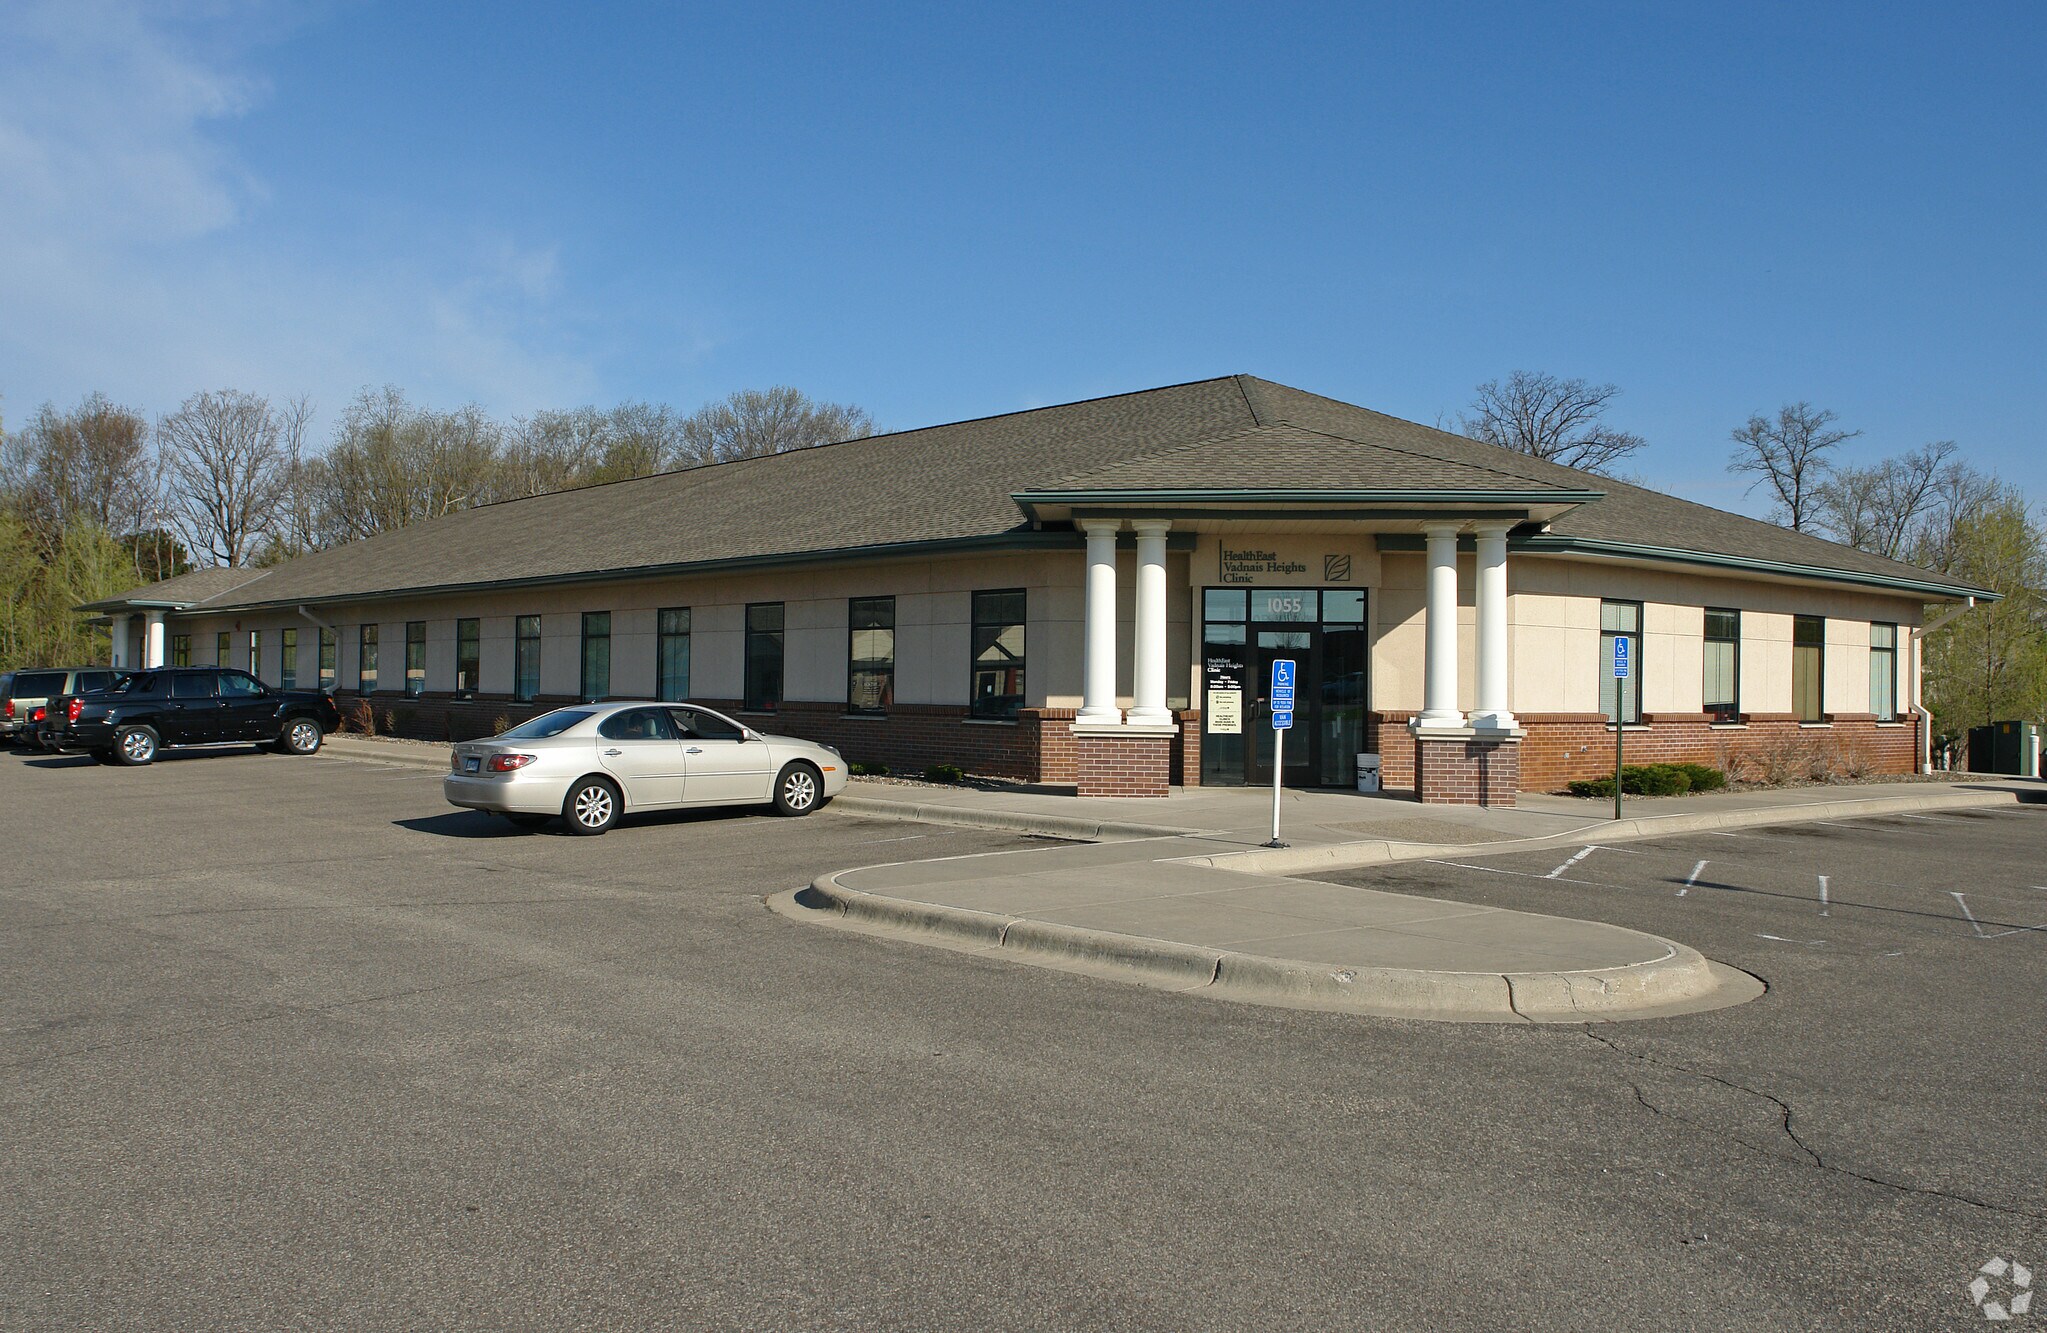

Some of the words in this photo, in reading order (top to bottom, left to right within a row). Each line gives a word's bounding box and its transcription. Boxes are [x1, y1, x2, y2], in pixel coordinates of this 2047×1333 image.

[1223, 550, 1276, 561] HealthEast
[1224, 562, 1263, 572] Vadnais
[1267, 562, 1306, 574] Heights
[1223, 573, 1253, 583] Clinic
[1267, 598, 1301, 613] 1055
